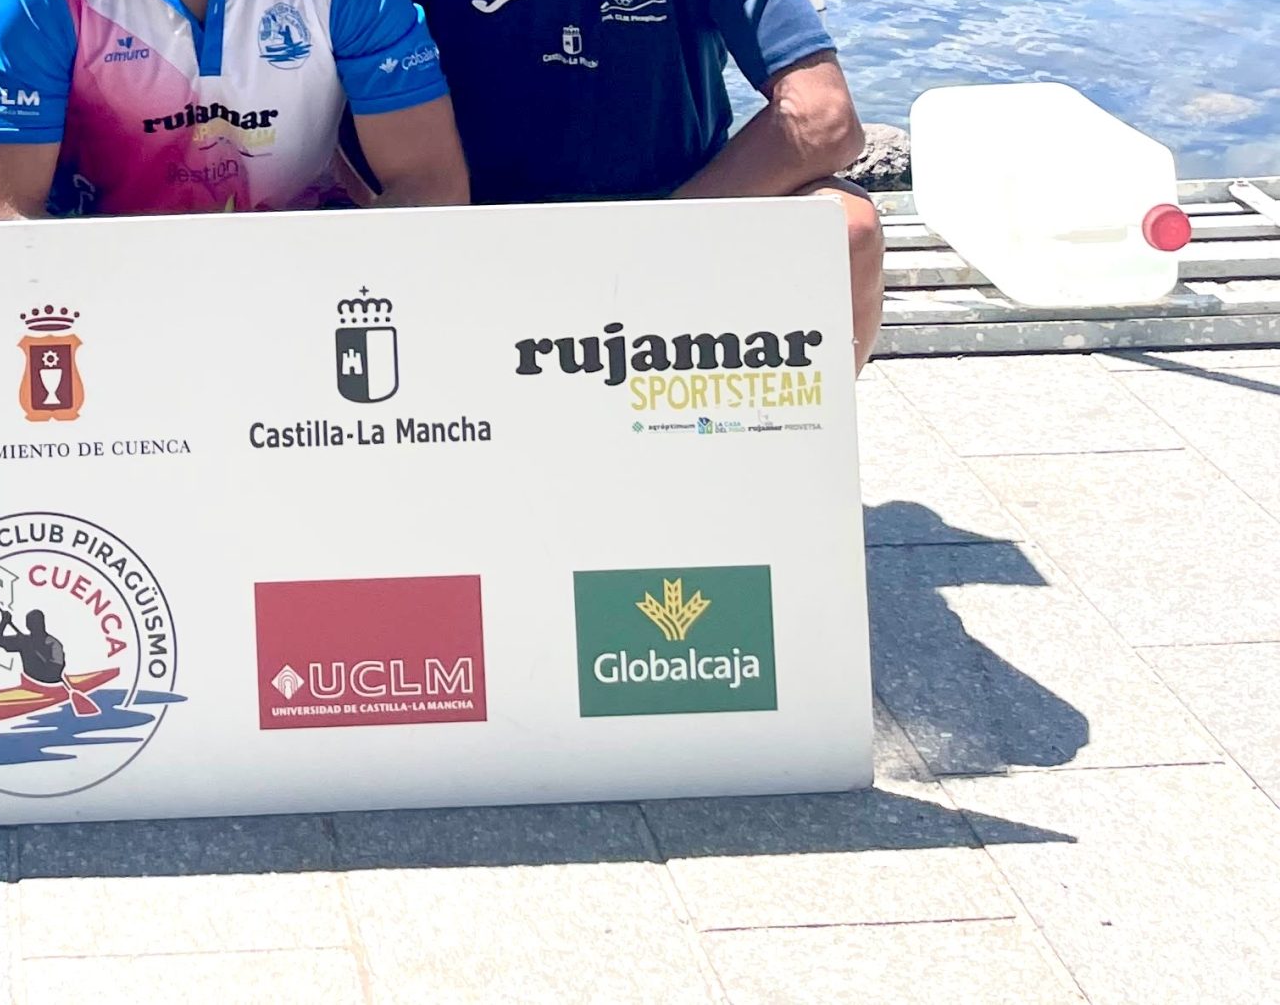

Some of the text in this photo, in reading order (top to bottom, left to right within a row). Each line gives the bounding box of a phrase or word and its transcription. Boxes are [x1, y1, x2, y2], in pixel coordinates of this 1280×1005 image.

[104, 49, 149, 62] amura
[142, 102, 279, 133] rujamar
[514, 322, 823, 386] rujamar
[629, 371, 822, 410] SPORTSTEAM
[78, 442, 104, 457] DE
[111, 440, 191, 456] CUENCA
[249, 416, 491, 448] Castilla-La Mancha
[28, 564, 127, 658] CUENCA
[72, 530, 168, 679] PIRAGÜISMO
[309, 657, 473, 699] UCLM
[593, 648, 760, 689] Globalcaja
[271, 700, 473, 717] UNIVERSIDAD DE CASTILLA-LA MANCHA
